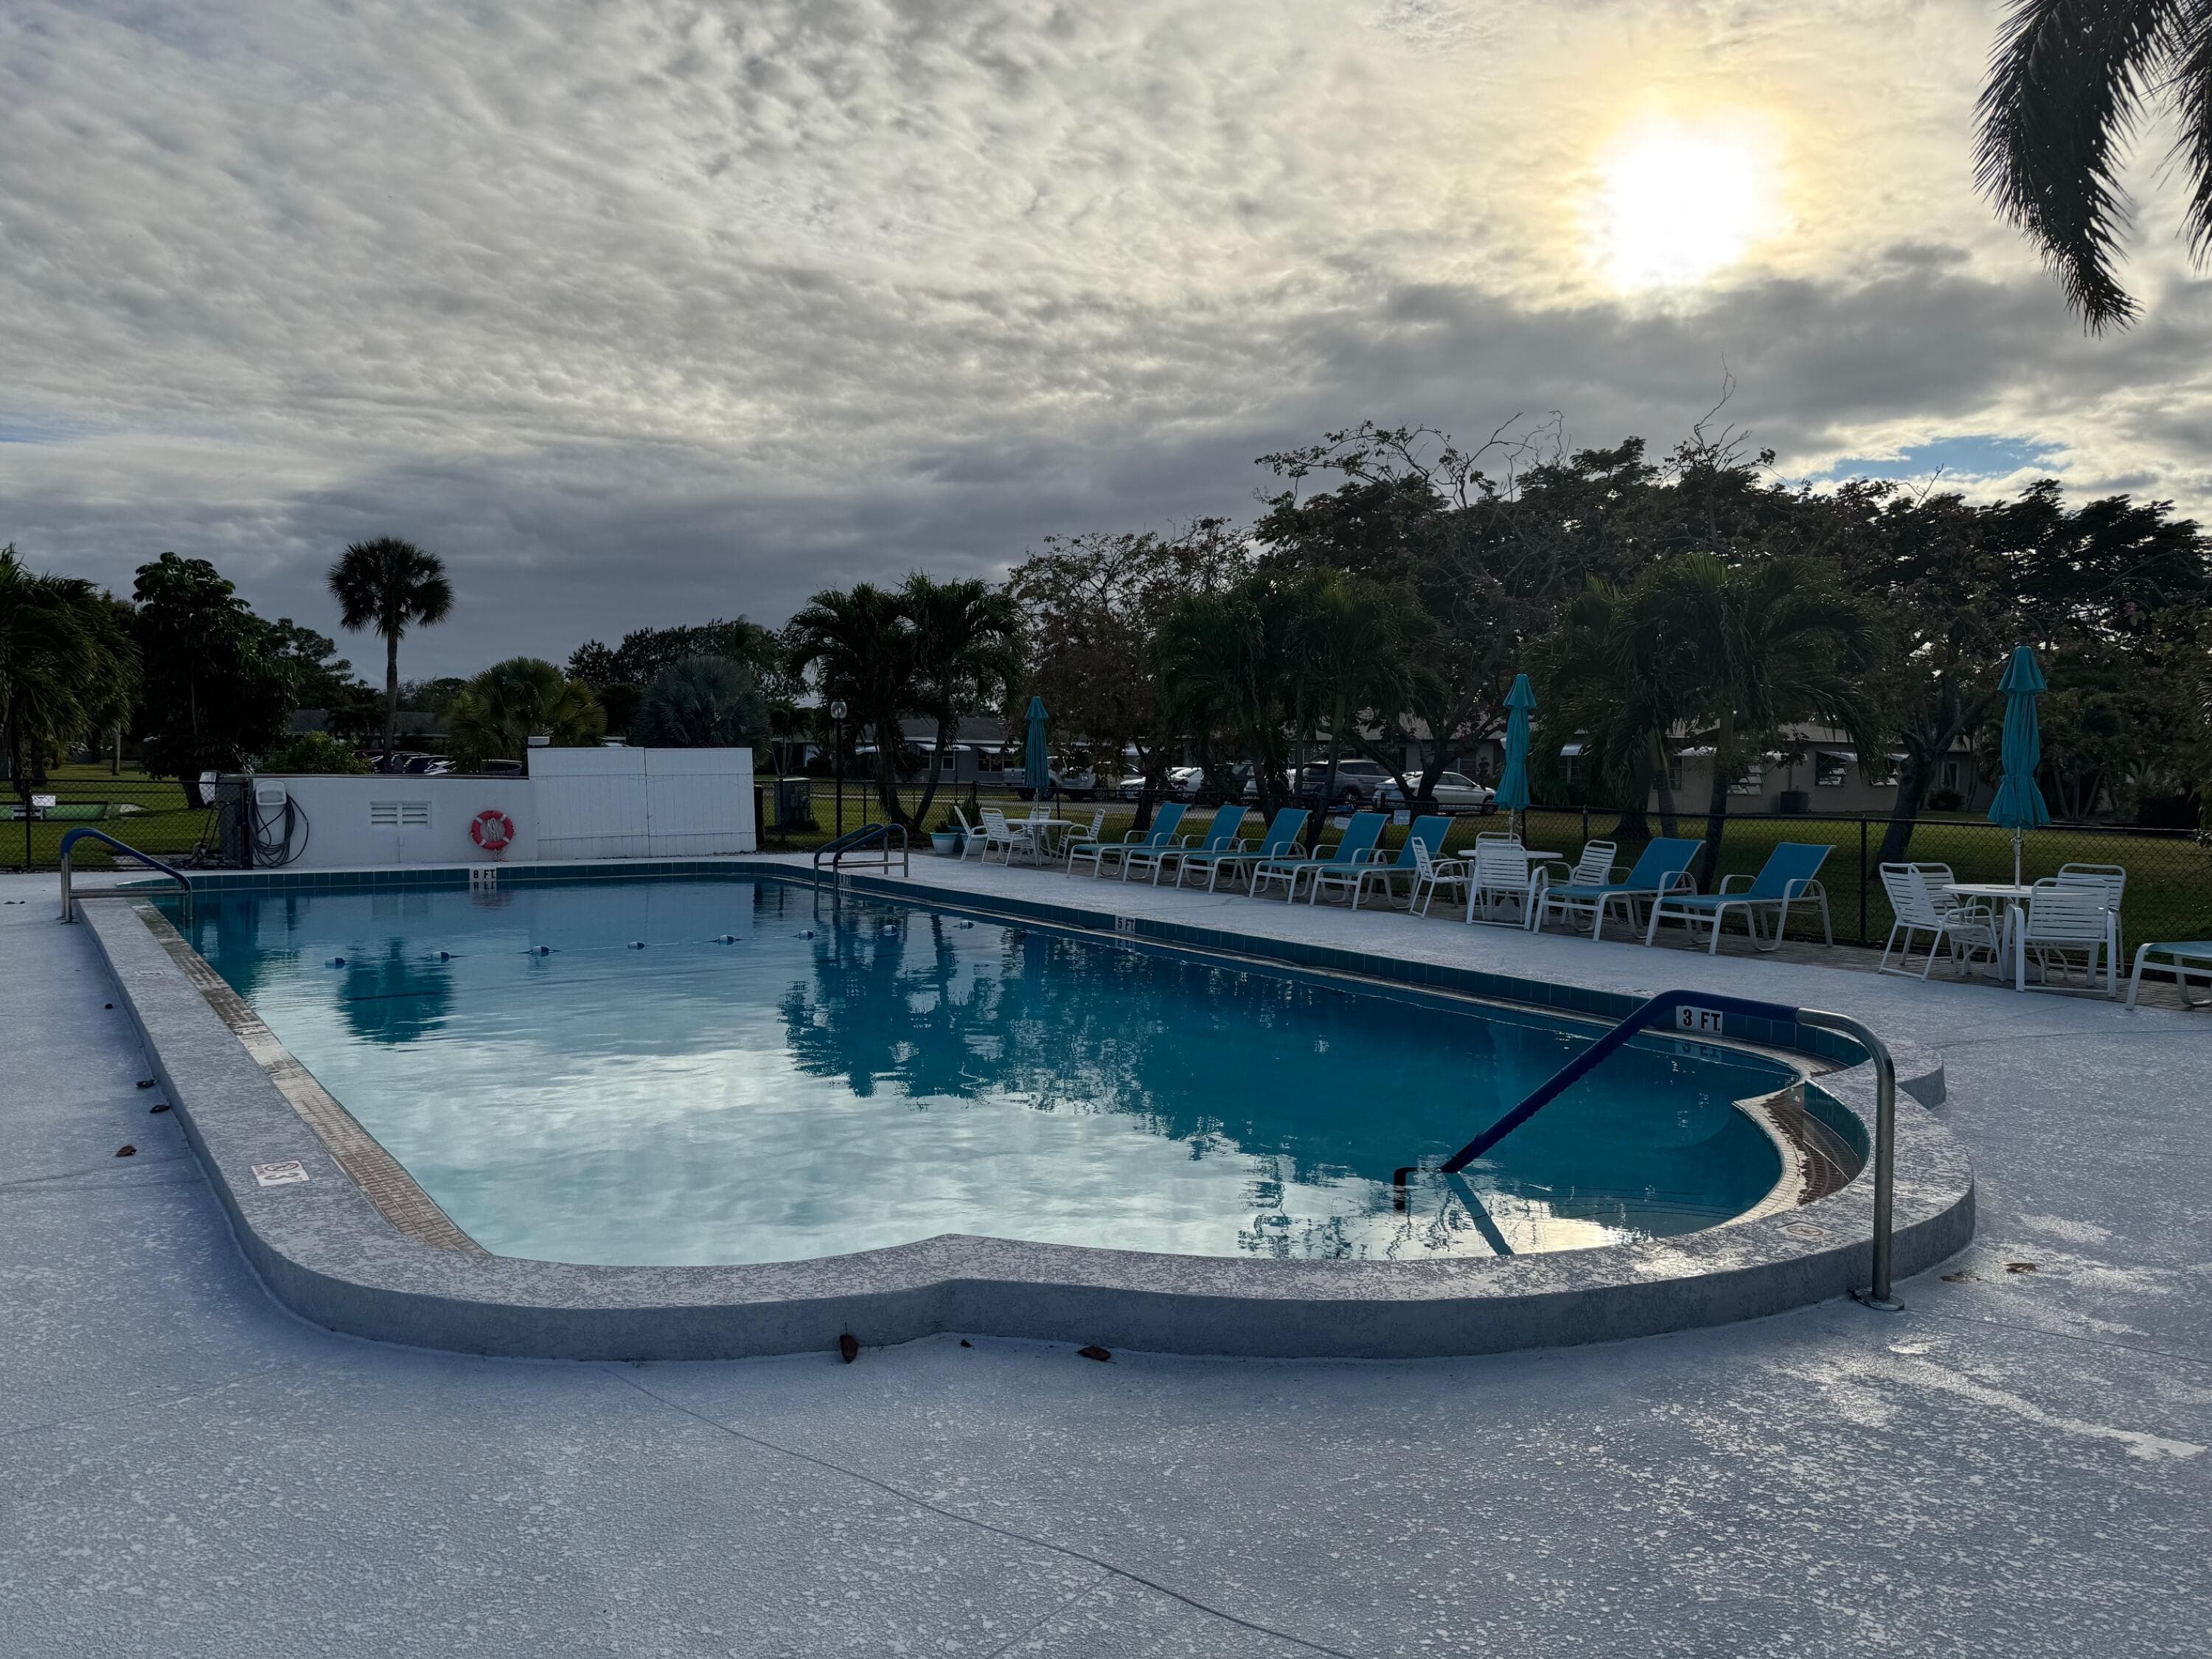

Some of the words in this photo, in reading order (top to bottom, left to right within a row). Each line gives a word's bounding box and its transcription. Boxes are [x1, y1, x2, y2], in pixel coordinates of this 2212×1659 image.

[473, 870, 479, 878] 8
[1118, 917, 1122, 929] 5
[1683, 1009, 1692, 1026] 3
[1700, 1012, 1721, 1032] FT.
